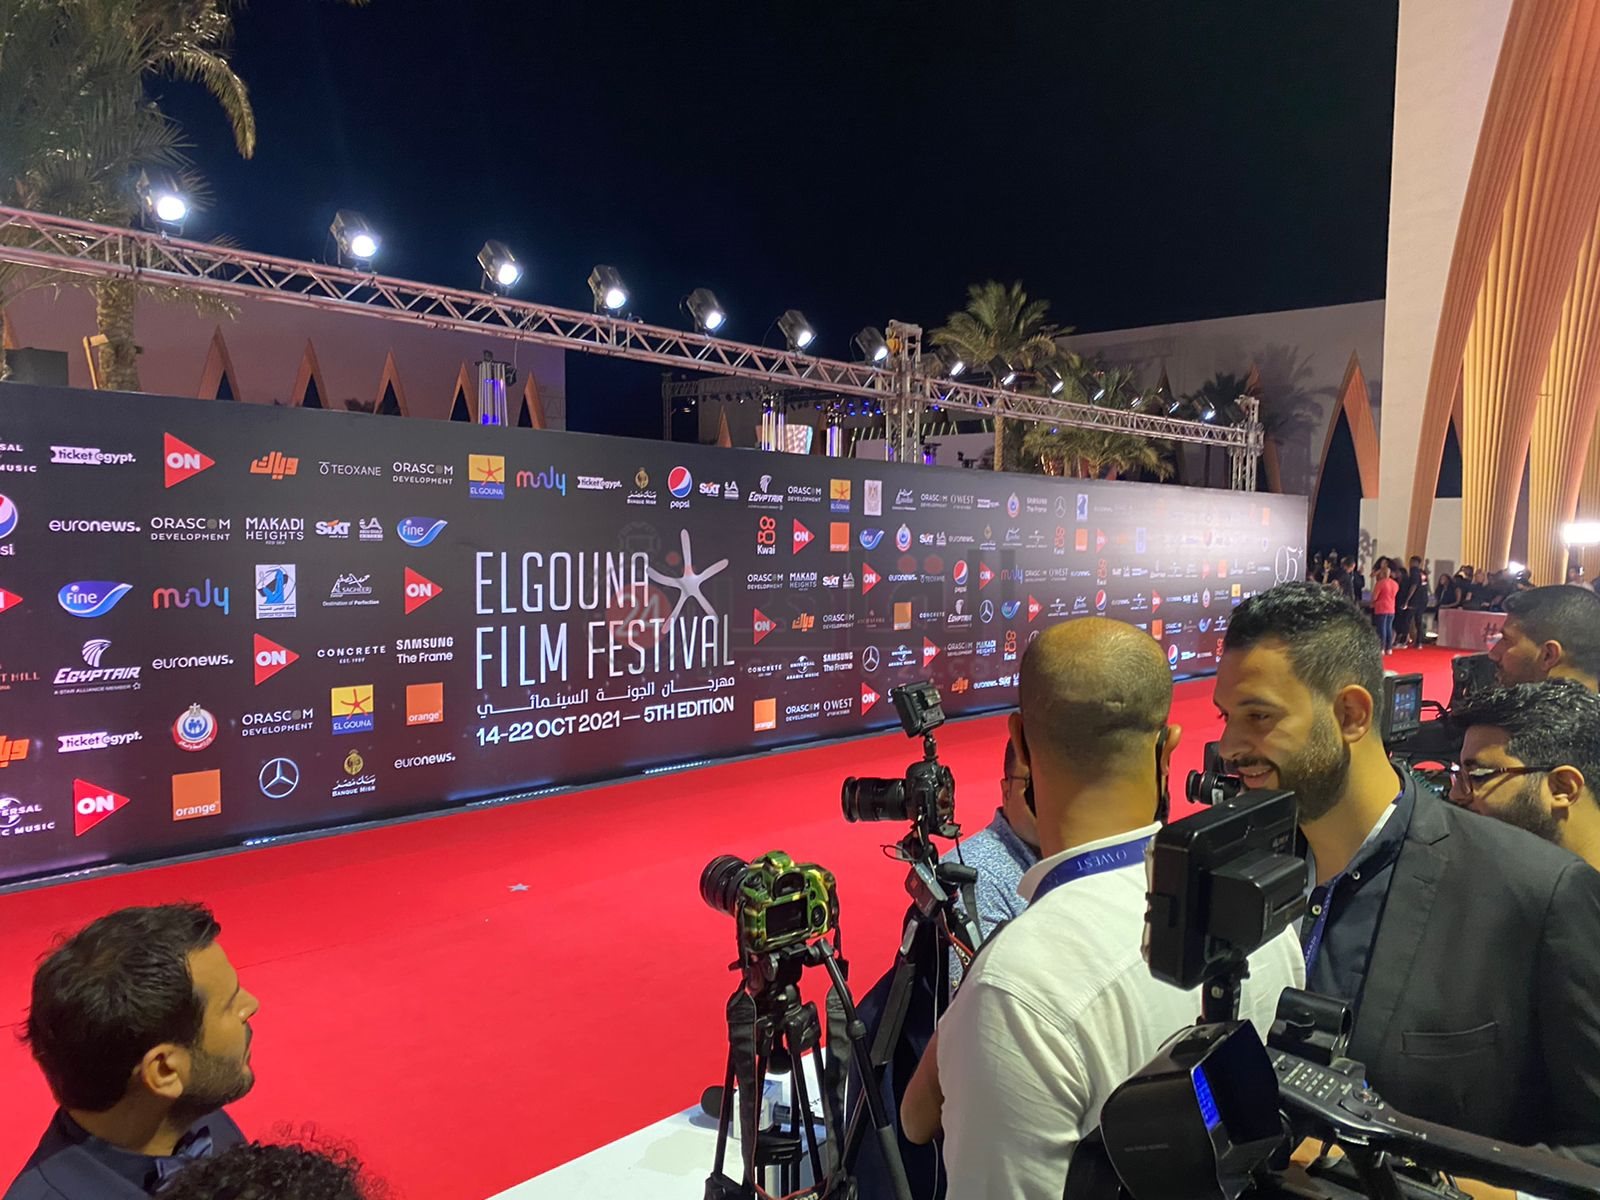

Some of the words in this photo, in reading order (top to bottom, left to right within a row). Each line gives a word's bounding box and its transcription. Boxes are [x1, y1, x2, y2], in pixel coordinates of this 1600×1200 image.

[166, 452, 201, 470] ON
[331, 464, 382, 476] TEOXANE
[392, 476, 454, 485] DEVELOPMENT
[669, 500, 690, 509] pepsi
[246, 517, 304, 530] MAKADI
[402, 519, 424, 535] fine
[150, 532, 231, 541] DEVELOPMENT
[246, 531, 304, 541] HEIGHTS
[794, 531, 809, 541] ON
[757, 545, 776, 555] Kwai
[863, 574, 877, 583] ON
[65, 584, 98, 604] fine
[406, 583, 432, 598] ON
[754, 621, 770, 631] ON
[396, 637, 454, 650] SAMSUNG
[317, 645, 387, 658] CONCRETE
[396, 653, 417, 664] The
[419, 651, 454, 663] Frame
[476, 622, 568, 690] FILM
[587, 614, 735, 680] FESTIVAL
[256, 650, 287, 667] ON
[661, 675, 735, 698] مهرجان
[862, 692, 876, 703] ON
[408, 713, 440, 722] orange
[476, 725, 534, 746] 14-22
[535, 716, 577, 739] OCT
[578, 710, 621, 733] 2021
[644, 703, 675, 723] 5TH
[677, 696, 735, 719] EDITION
[242, 722, 313, 736] DEVELOPMENT
[333, 722, 343, 730] EL
[344, 719, 372, 729] GOUNA
[77, 794, 115, 815] ON
[175, 801, 216, 818] orange
[15, 822, 55, 834] MUSIC
